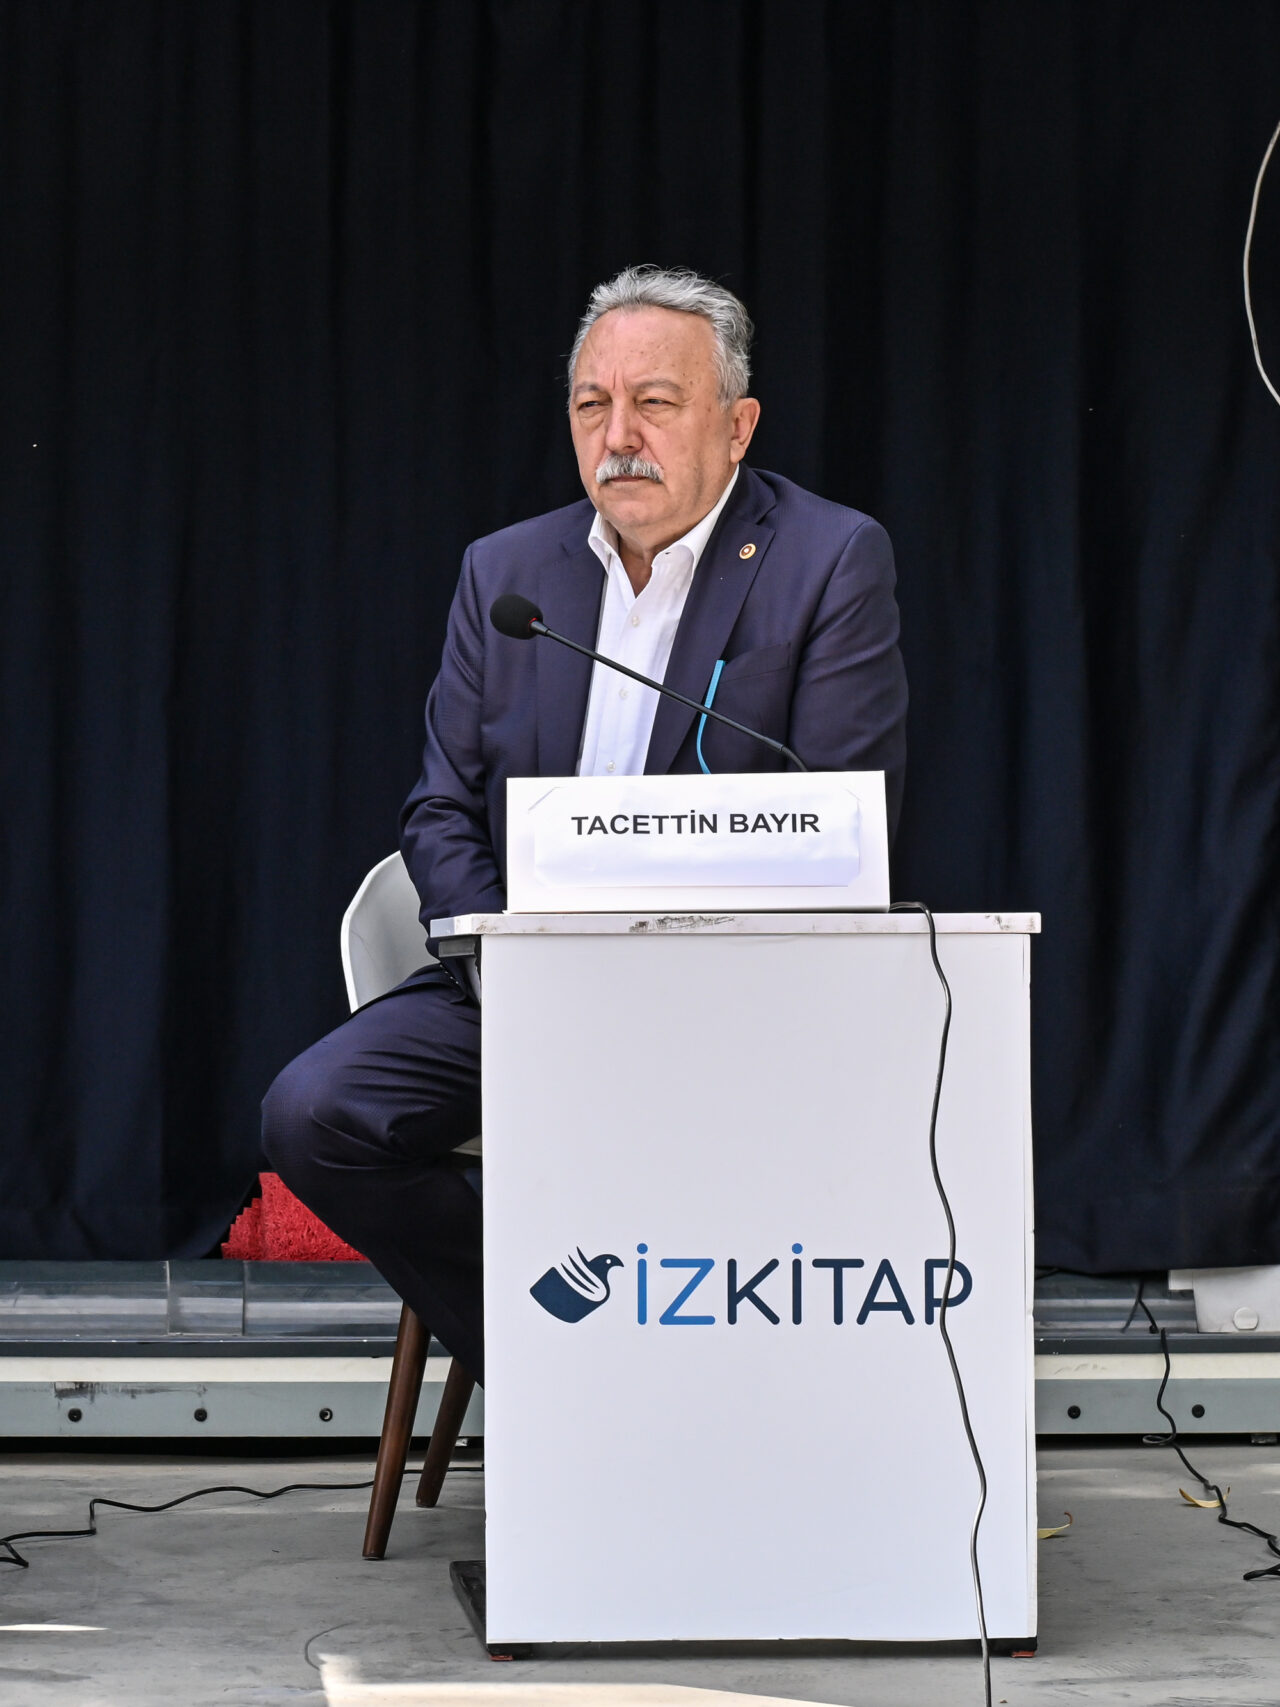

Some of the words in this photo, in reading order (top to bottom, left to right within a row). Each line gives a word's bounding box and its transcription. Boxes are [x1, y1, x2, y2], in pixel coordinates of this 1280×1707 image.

[571, 809, 718, 836] TACETTİN
[729, 813, 821, 833] BAYIR
[636, 1242, 974, 1326] İZKİTAP
